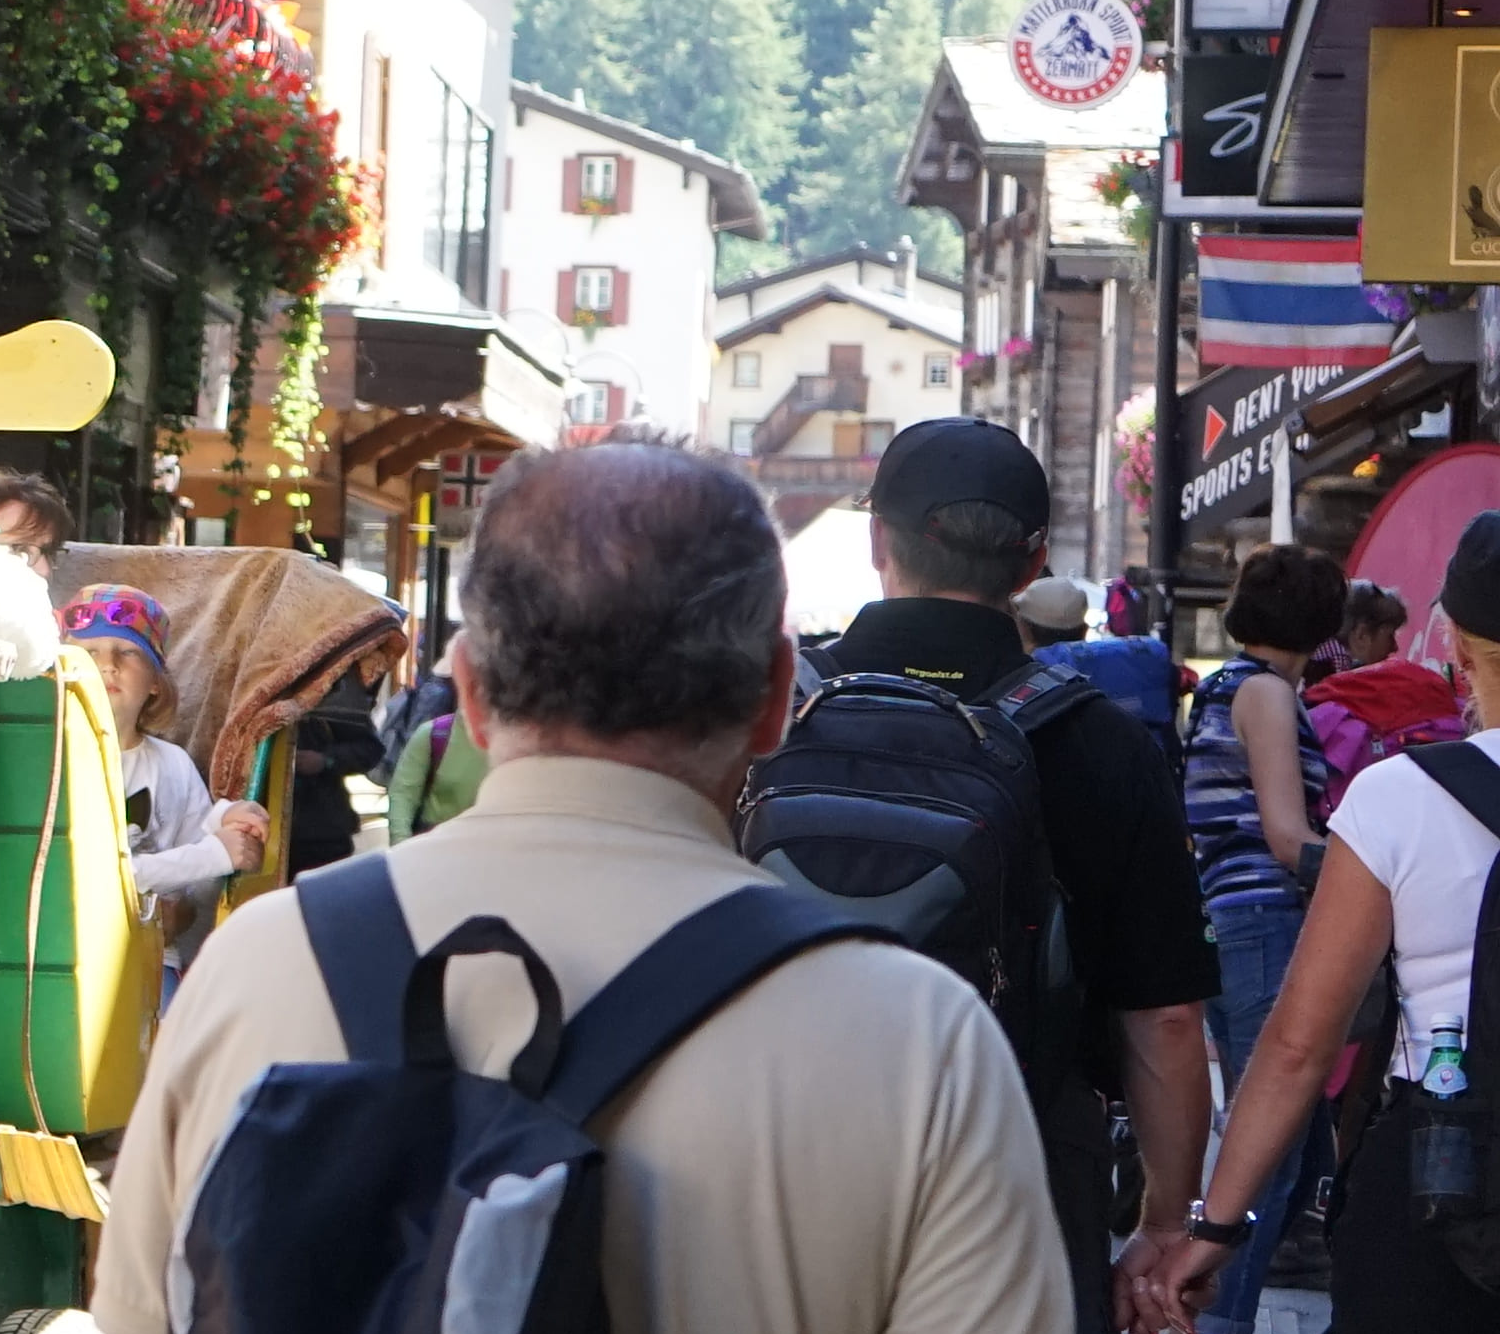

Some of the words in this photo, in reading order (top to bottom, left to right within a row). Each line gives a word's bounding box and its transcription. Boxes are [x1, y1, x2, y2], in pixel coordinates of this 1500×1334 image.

[1099, 3, 1133, 42] SPORT
[1044, 57, 1100, 79] ZERMATT
[1232, 373, 1285, 438] RENT
[1180, 446, 1253, 521] SPORTS
